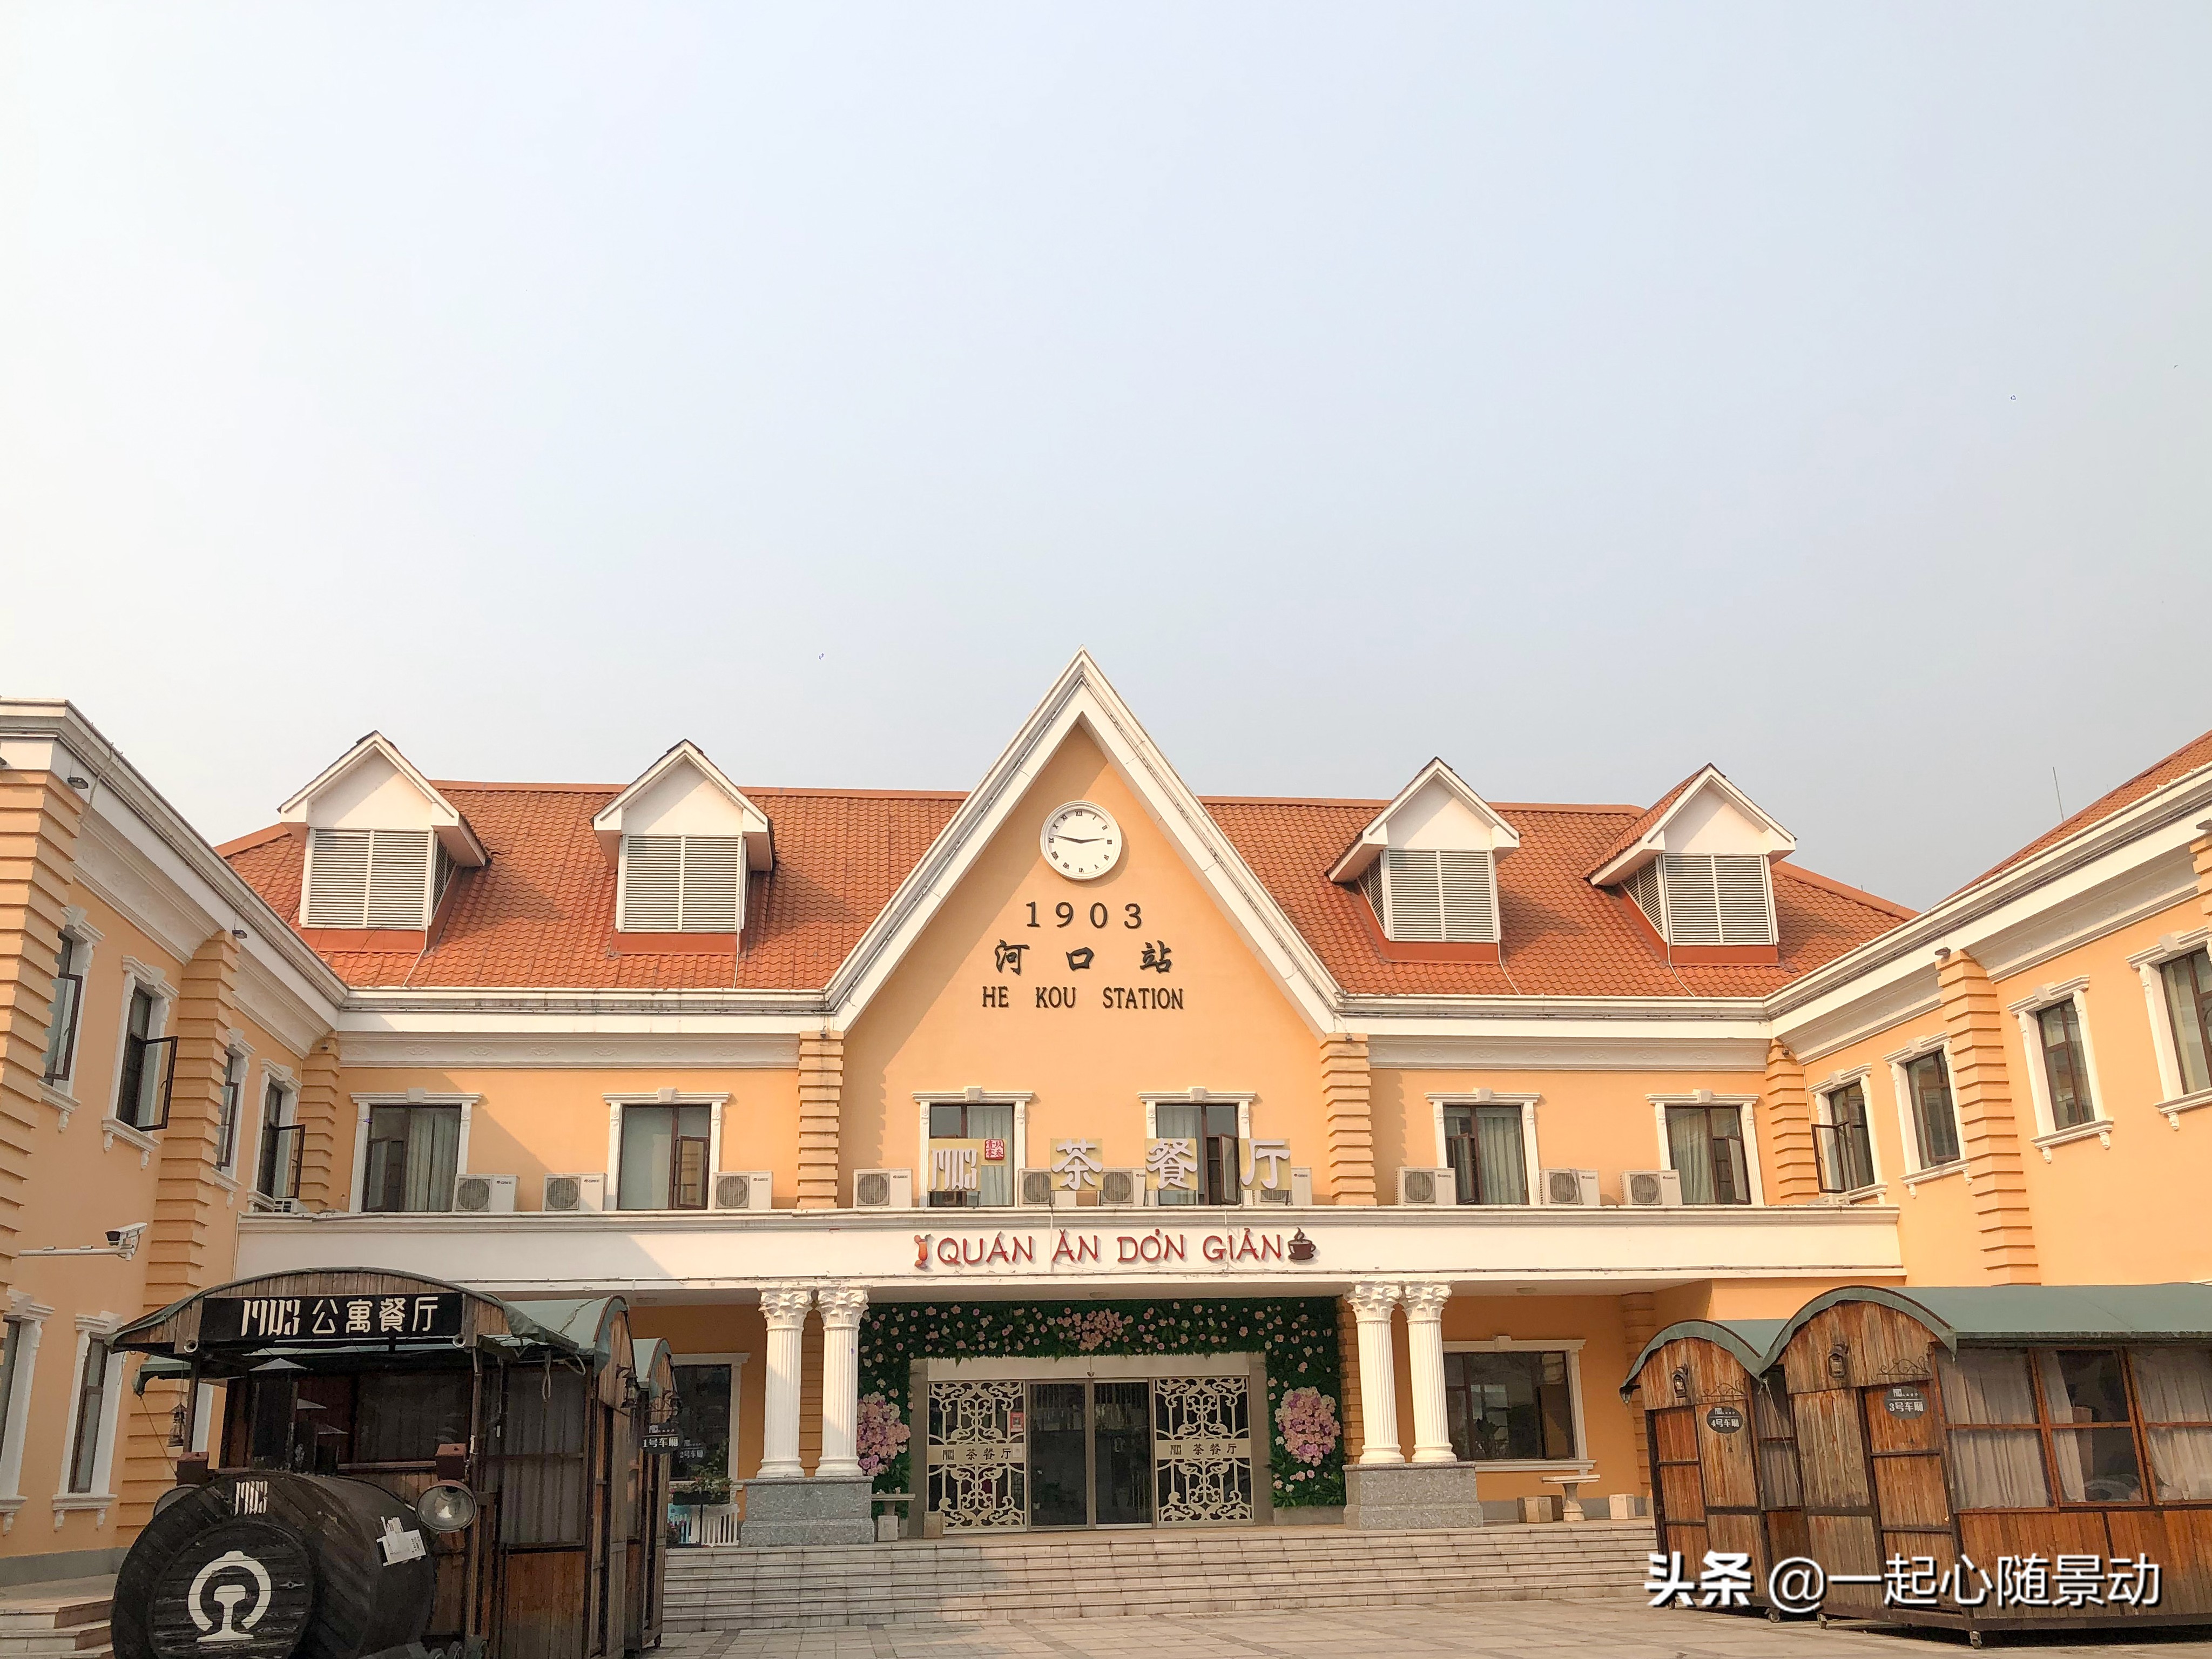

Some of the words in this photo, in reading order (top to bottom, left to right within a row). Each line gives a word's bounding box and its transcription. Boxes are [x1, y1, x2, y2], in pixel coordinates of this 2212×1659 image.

[1026, 901, 1142, 929] 1903
[994, 939, 1172, 975] 河口站
[982, 986, 1009, 1008] HE
[1035, 987, 1076, 1009] KOU
[1102, 987, 1184, 1010] STATION
[1051, 1138, 1290, 1190] 茶餐厅
[937, 1231, 1033, 1265] QUÁN
[312, 1296, 439, 1334] 公寓餐厅
